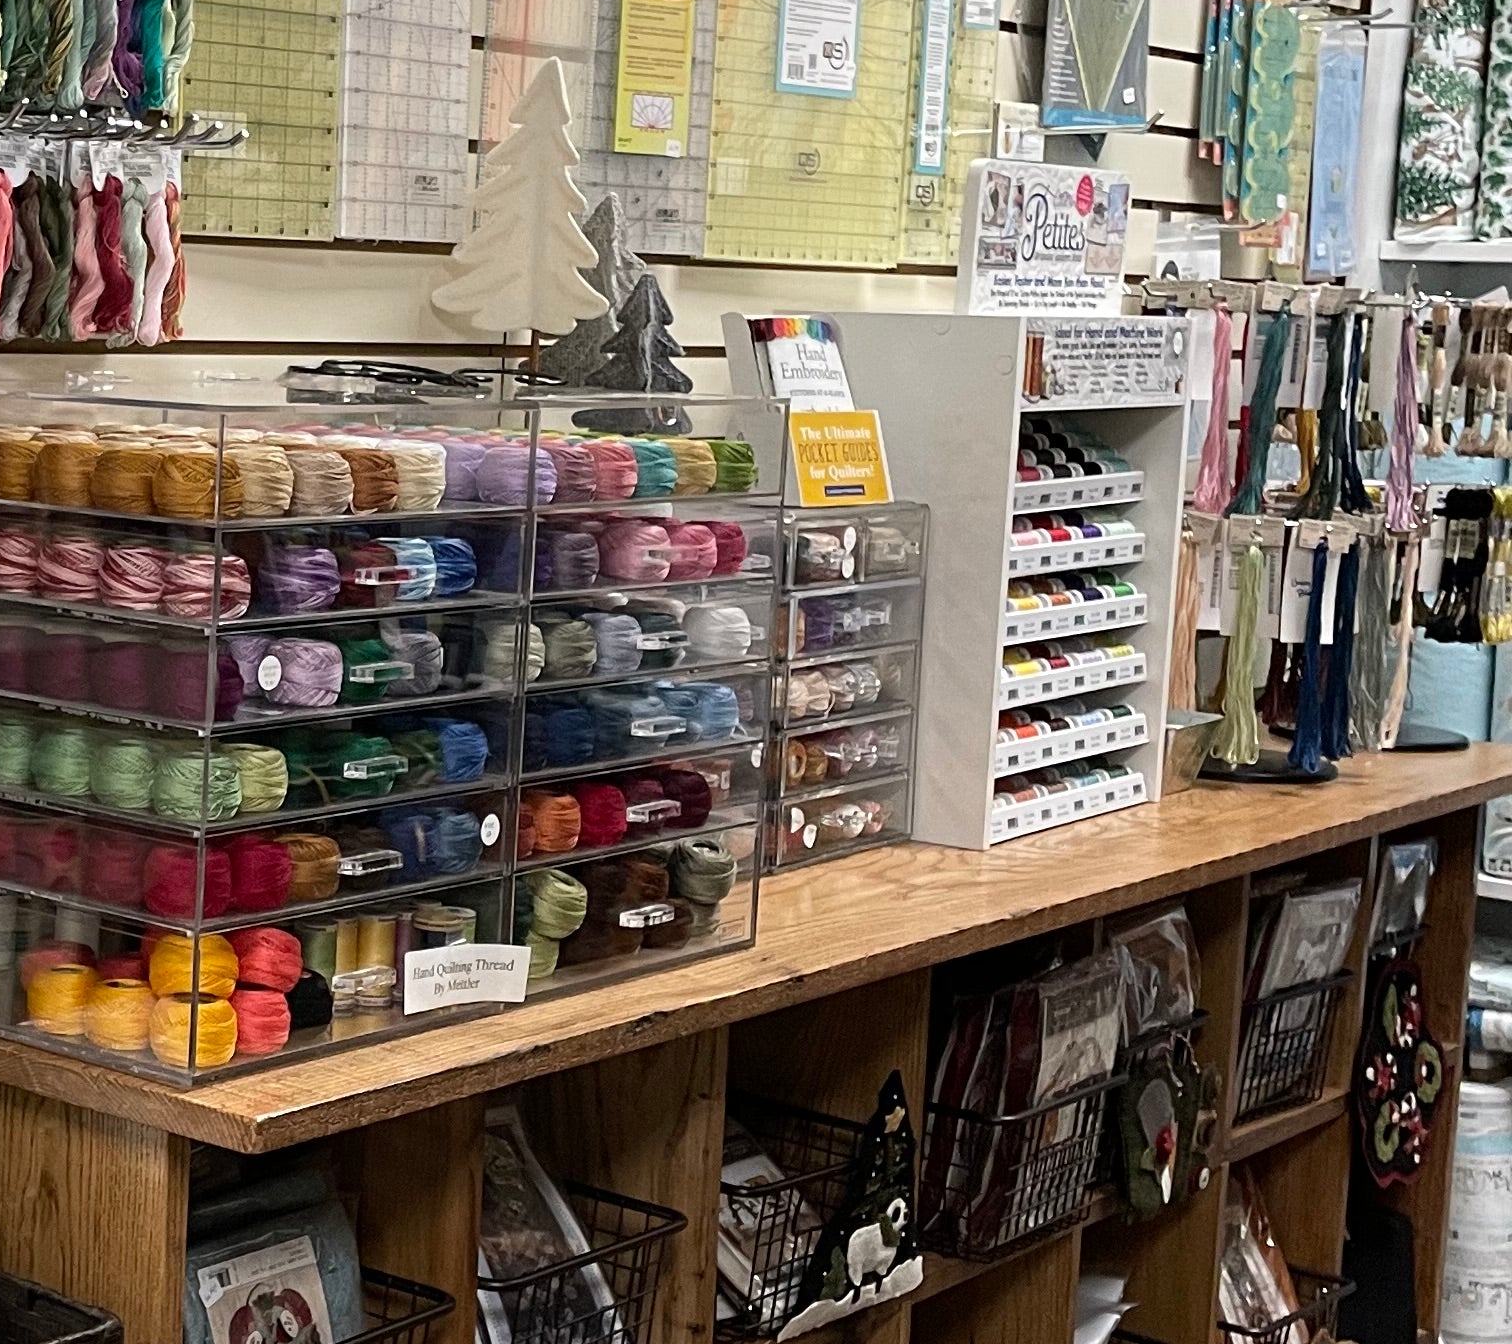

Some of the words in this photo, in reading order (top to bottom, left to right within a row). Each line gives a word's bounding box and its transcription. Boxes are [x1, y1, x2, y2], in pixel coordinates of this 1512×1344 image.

[1021, 192, 1086, 262] Petites
[796, 343, 827, 362] Hand
[781, 362, 842, 387] Embroidery
[800, 427, 821, 441] The
[824, 425, 871, 440] Ultimate
[798, 442, 839, 464] POCKET
[842, 441, 880, 463] GUIDES
[810, 466, 825, 479] for
[828, 463, 874, 481] Quilters!
[413, 964, 435, 980] Hand
[437, 961, 472, 977] Quilting
[475, 958, 514, 972] Thread
